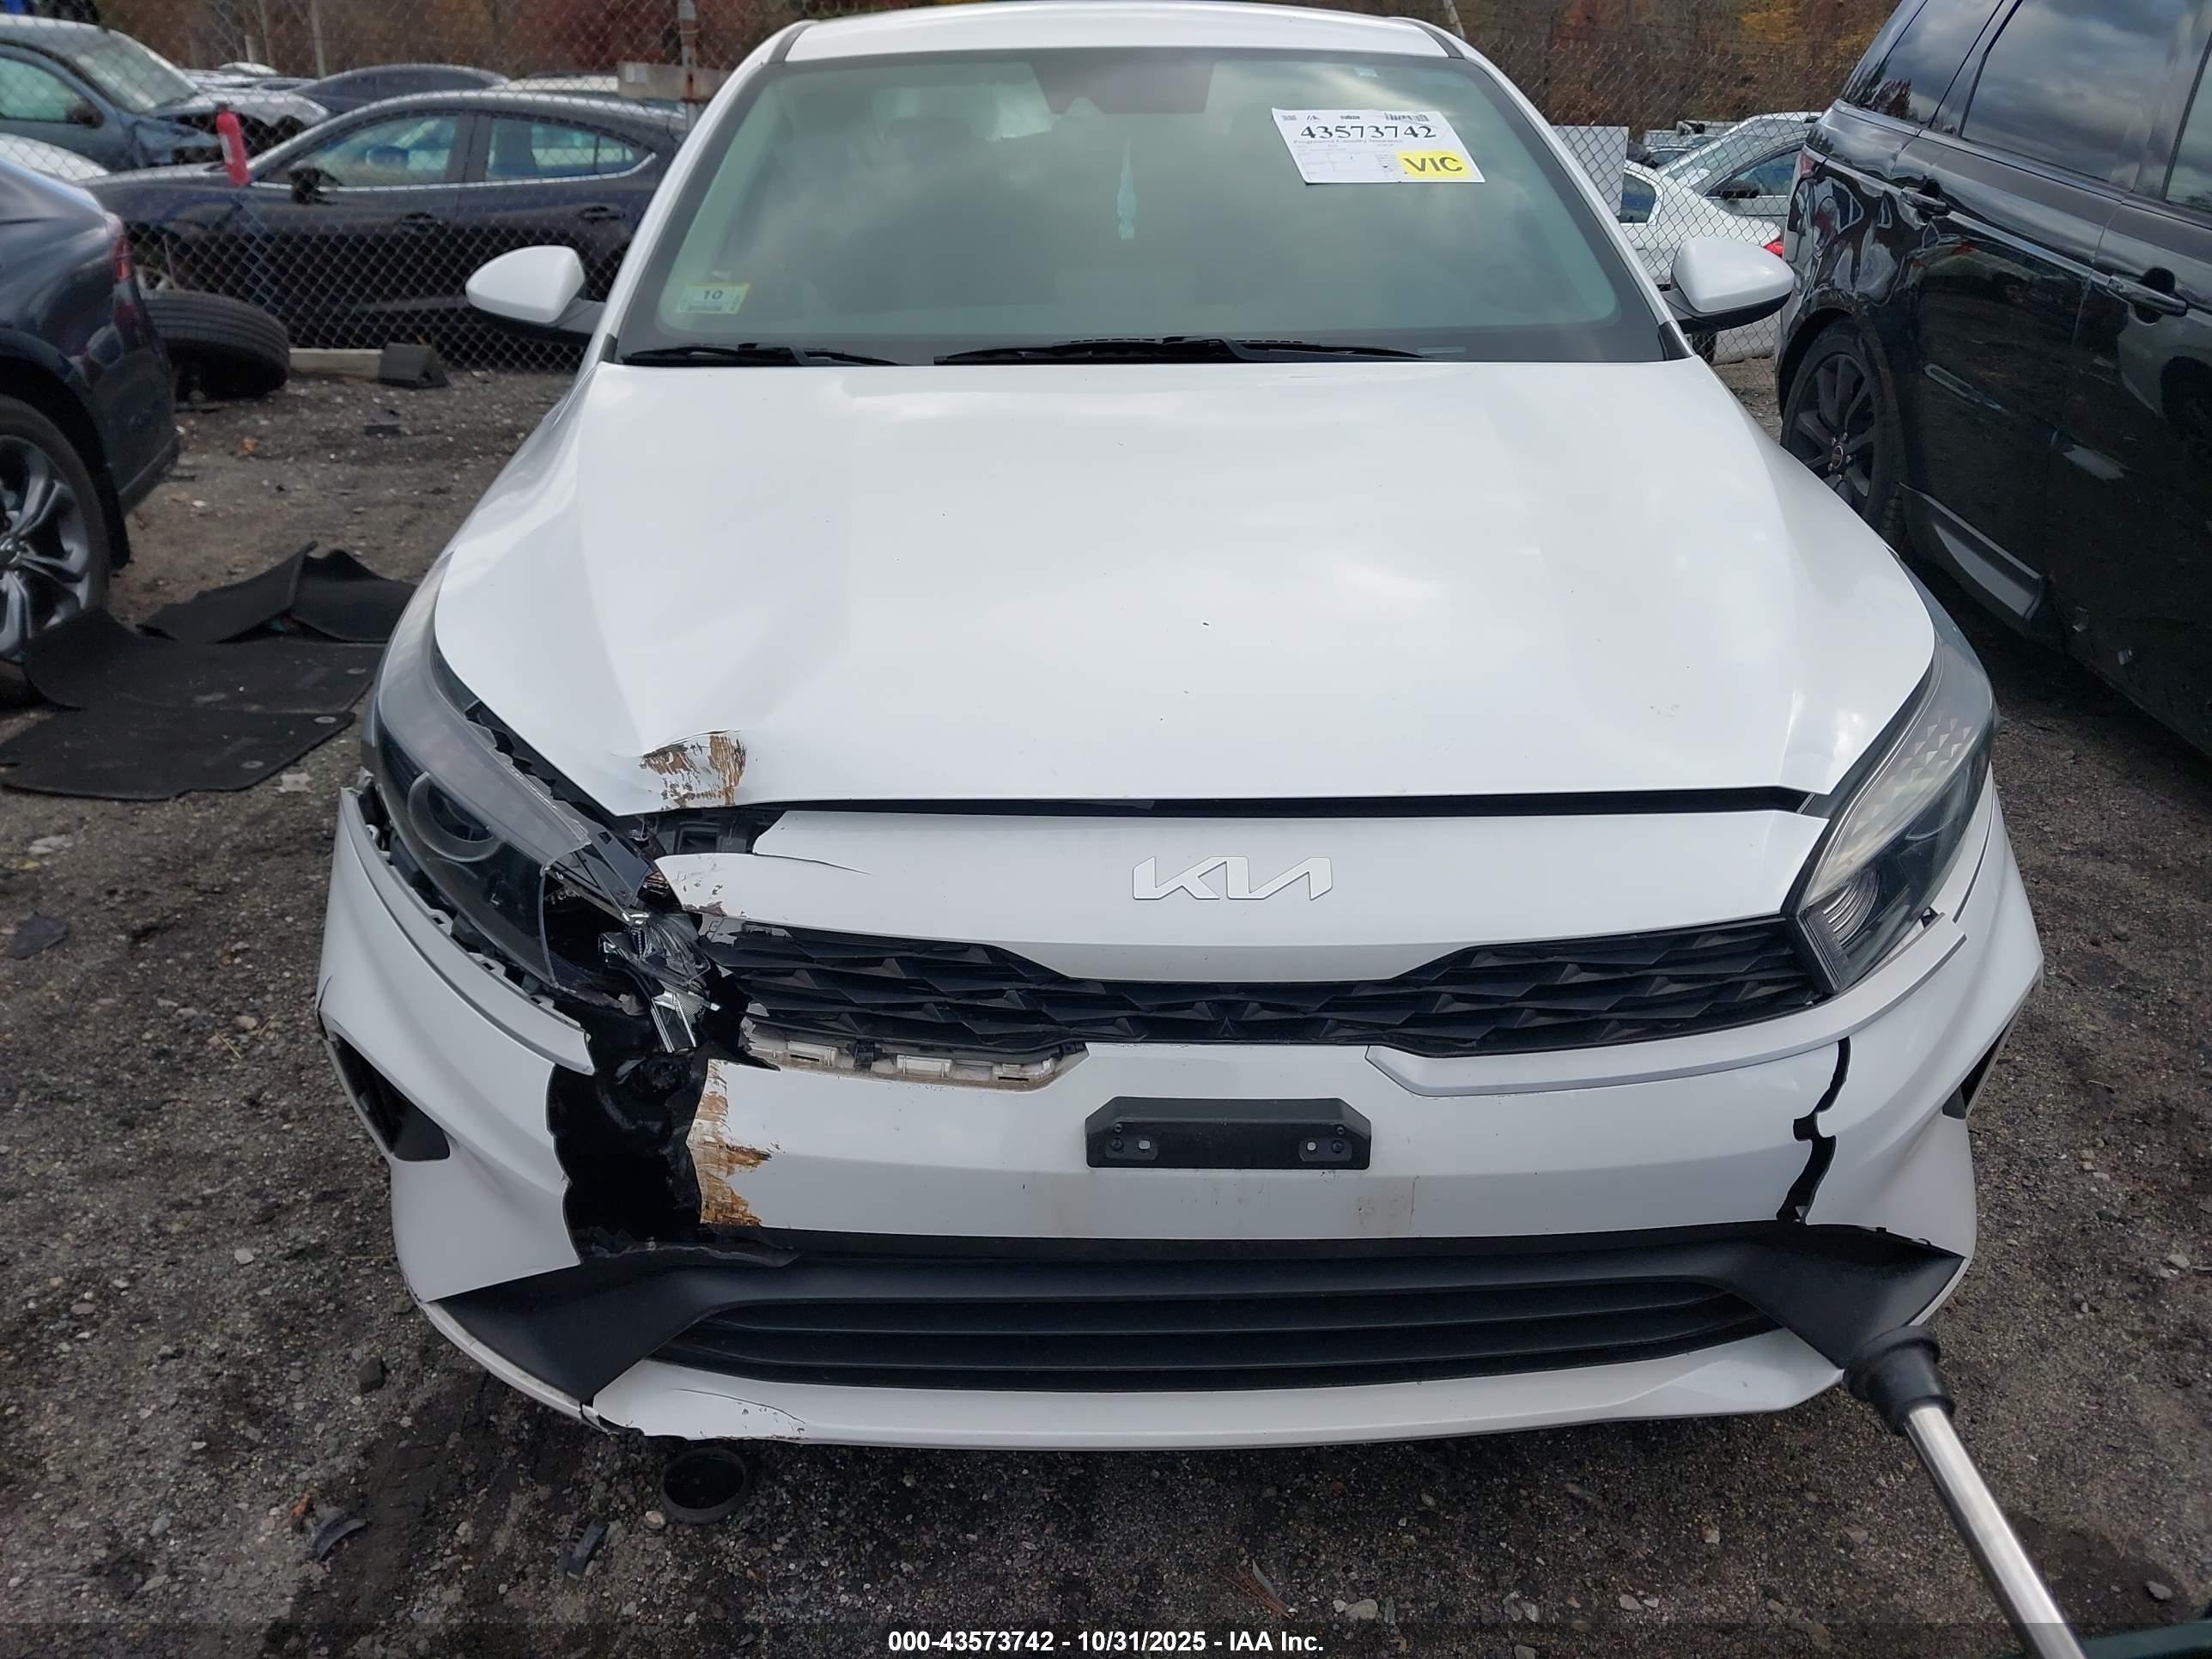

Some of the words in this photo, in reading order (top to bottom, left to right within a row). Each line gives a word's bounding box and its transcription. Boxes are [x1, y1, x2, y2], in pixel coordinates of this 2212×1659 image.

[1300, 125, 1437, 138] 43573742
[1403, 157, 1463, 172] VIC
[704, 290, 723, 301] 10
[1133, 855, 1333, 901] KIA
